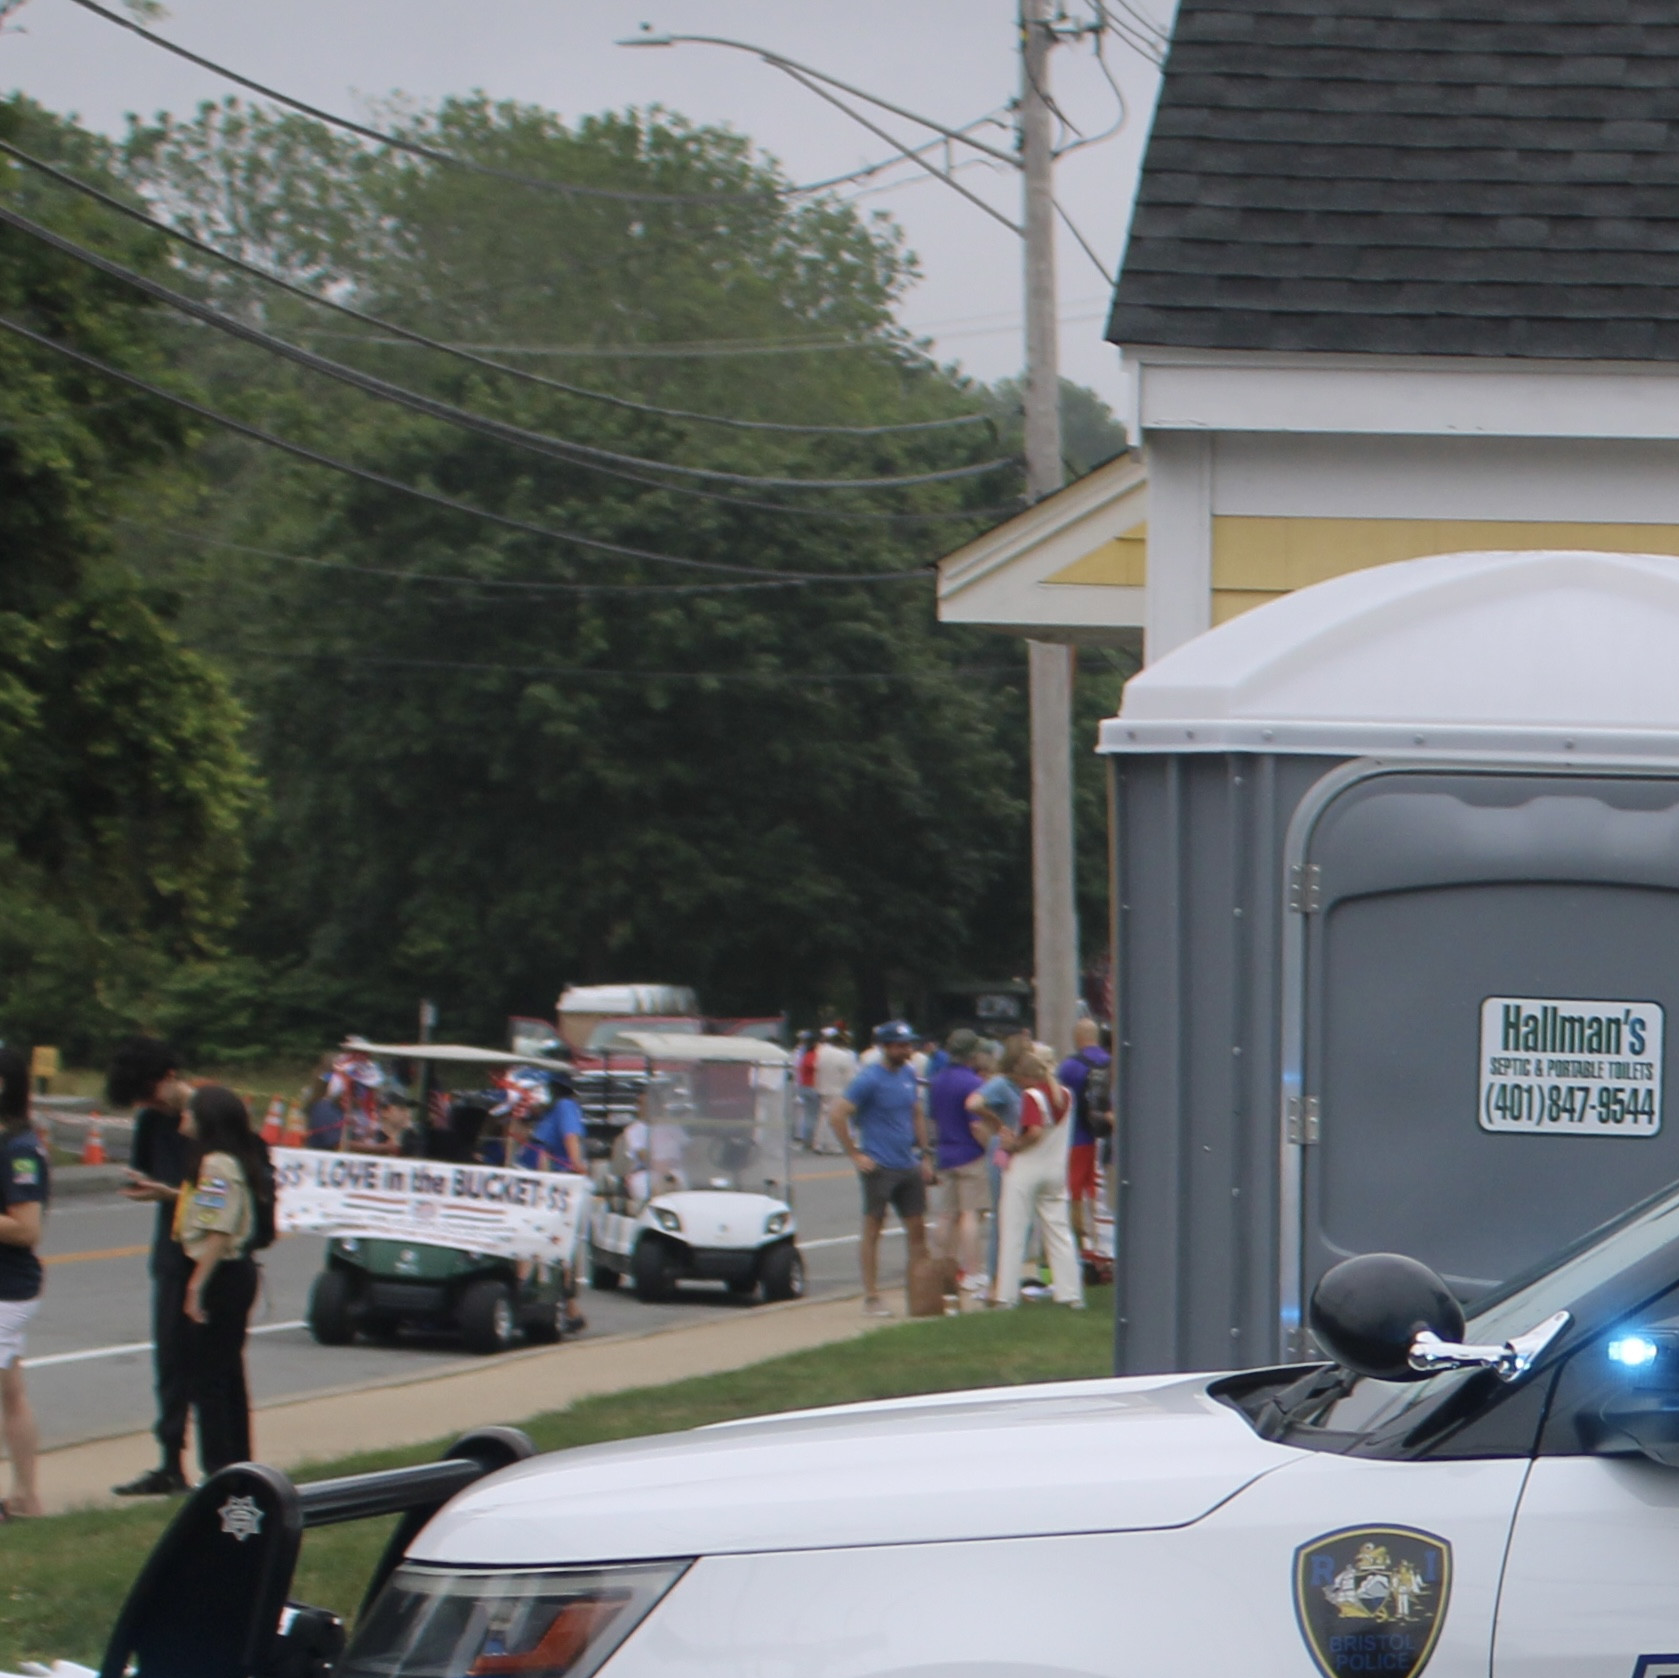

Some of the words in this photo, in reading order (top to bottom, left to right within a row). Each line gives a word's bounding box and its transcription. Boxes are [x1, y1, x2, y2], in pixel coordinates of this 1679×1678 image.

[1503, 1004, 1646, 1056] Hallman's
[1489, 1057, 1530, 1077] SEPTIC
[1534, 1058, 1543, 1078] &
[1547, 1059, 1603, 1080] PORTABLE
[1608, 1061, 1653, 1081] TOILETS
[1485, 1082, 1655, 1126] (401)847-9544
[316, 1159, 377, 1189] LOVE
[384, 1163, 404, 1191] in
[410, 1163, 446, 1193] the
[451, 1168, 542, 1206] BUCKET
[1310, 1554, 1335, 1586] R
[1424, 1550, 1437, 1582] I
[1329, 1634, 1415, 1652] BRISTOL
[1336, 1653, 1410, 1671] POLICE
